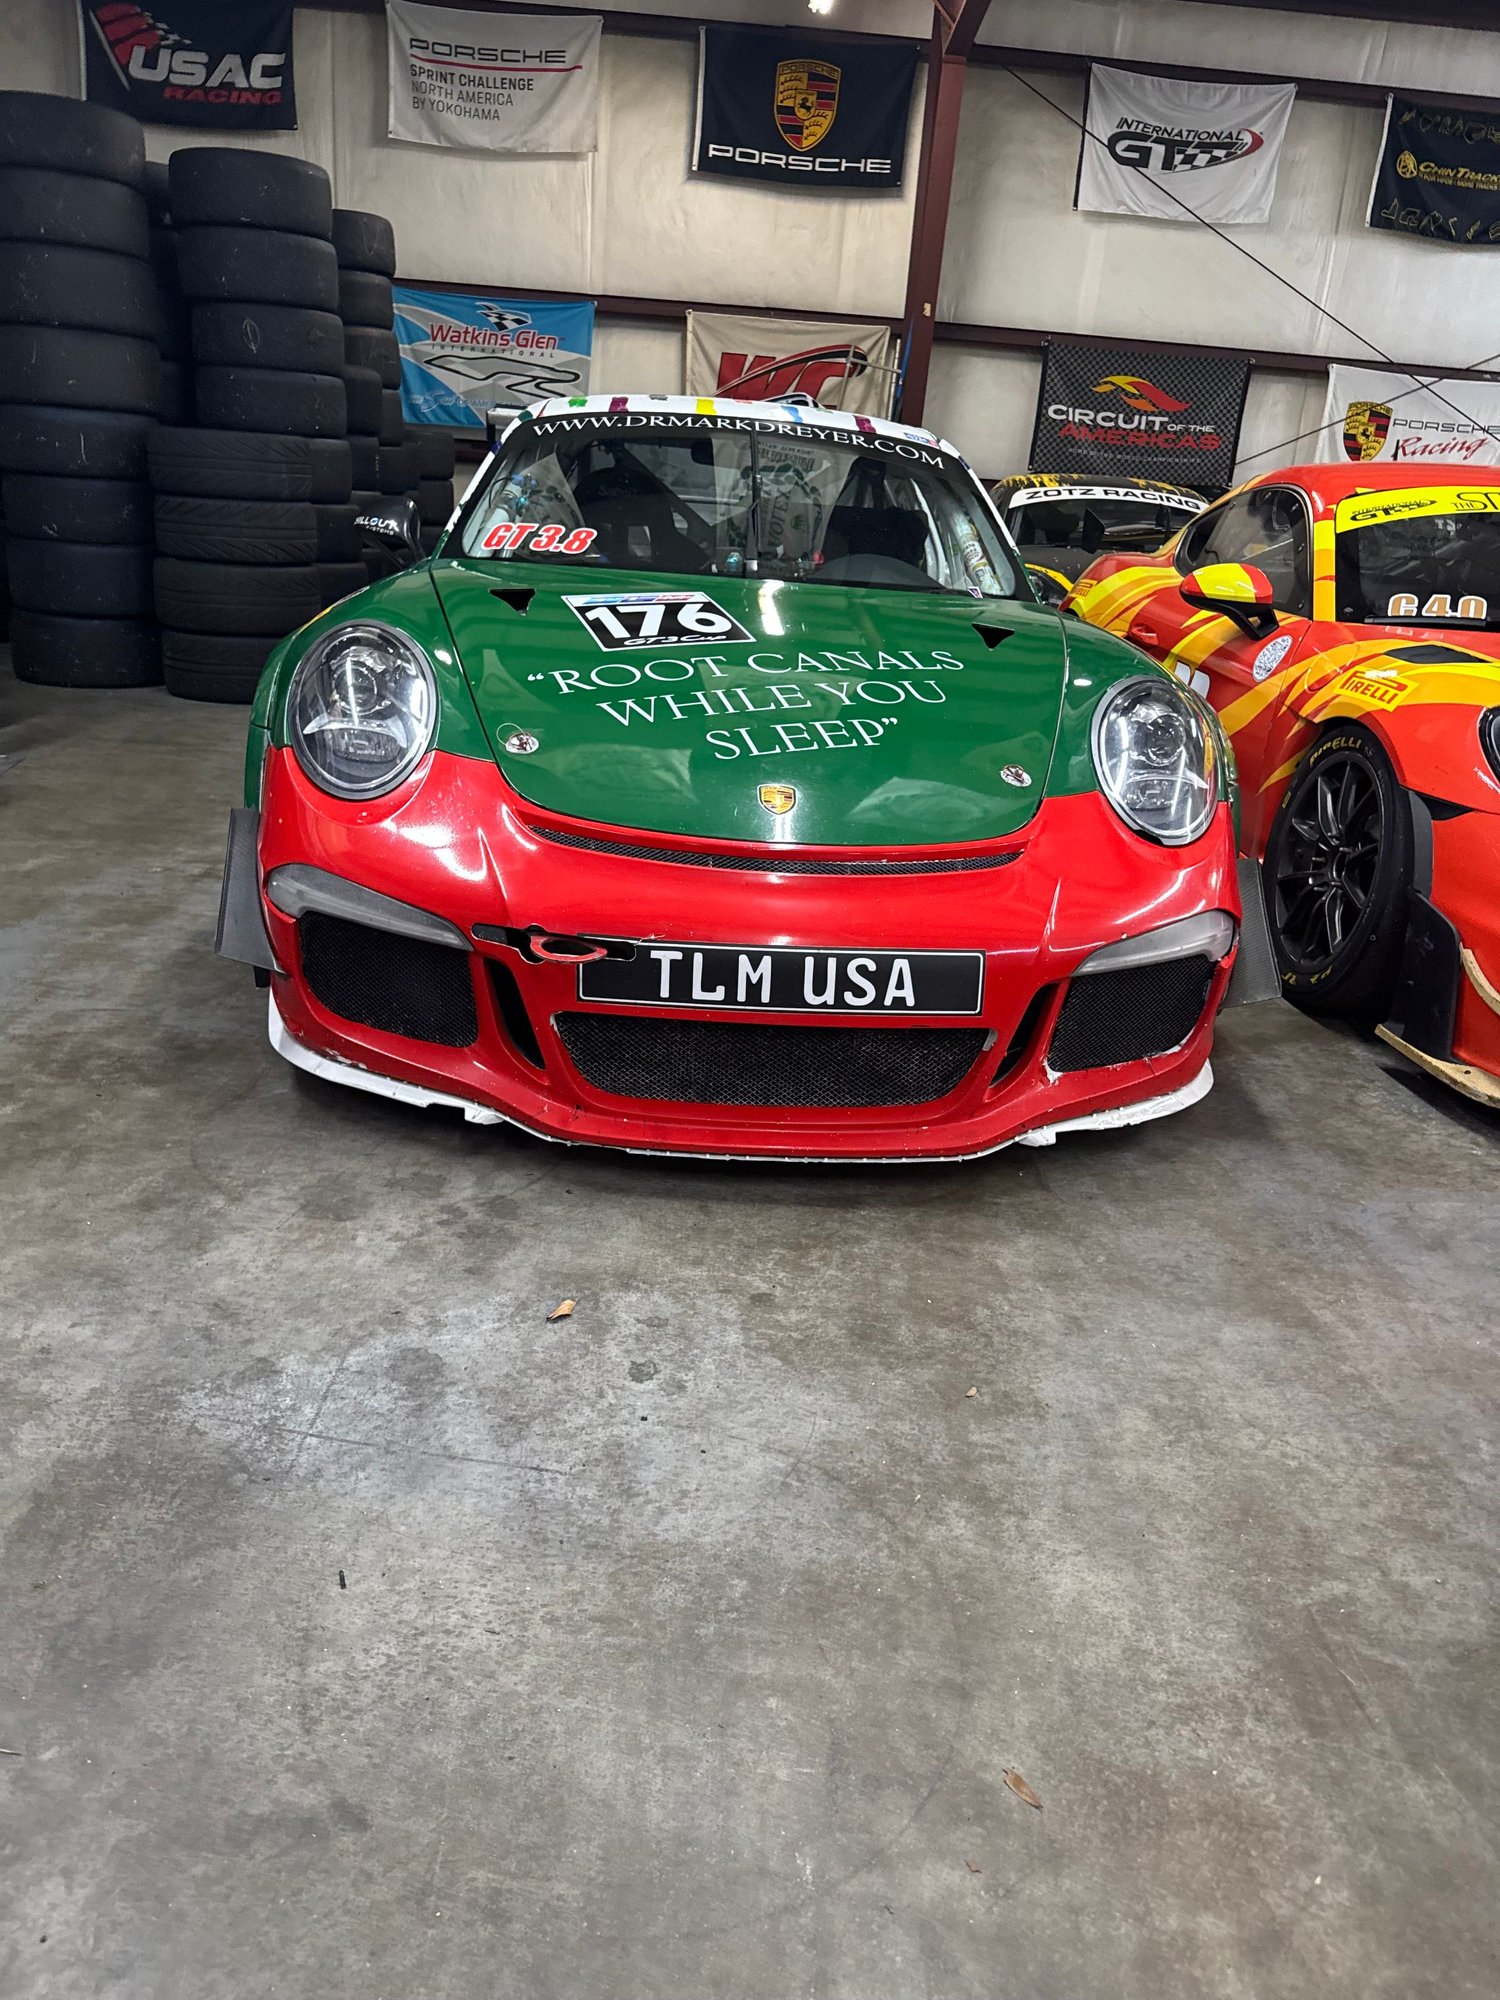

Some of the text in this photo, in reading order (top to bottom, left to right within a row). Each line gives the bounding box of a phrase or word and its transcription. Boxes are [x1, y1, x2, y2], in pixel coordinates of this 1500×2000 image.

[409, 37, 567, 63] PORSCHE
[129, 44, 286, 89] USAC
[410, 64, 534, 91] SPRINT CHALLENGE
[781, 63, 838, 79] PORSCHE
[162, 85, 283, 105] RACING
[411, 80, 514, 106] NORTH AMERICA
[412, 96, 500, 121] BY YOKOHAMA
[1116, 117, 1246, 142] INTERNATIONAL
[708, 144, 891, 173] PORSCHE
[430, 323, 559, 350] Watkins Glen
[431, 343, 555, 358] INTERNATIONAL
[1048, 404, 1216, 433] CIRCUIT OF THE
[1392, 418, 1500, 435] PORSCHE
[532, 415, 945, 470] WWW.DRMARKDREYER.COM
[1058, 424, 1222, 451] AMERICAS
[1391, 437, 1488, 461] Racing
[1026, 488, 1201, 511] ZOTZ RACING
[481, 523, 597, 554] GT 3.8
[585, 604, 732, 639] 176
[527, 650, 965, 695] “ROOT CANALS
[1340, 670, 1408, 704] PIRELLI
[596, 680, 947, 728] WHILE YOU
[705, 717, 899, 760] SLEEP”
[1310, 736, 1362, 767] PIRELLI
[650, 950, 916, 1007] TLM USA
